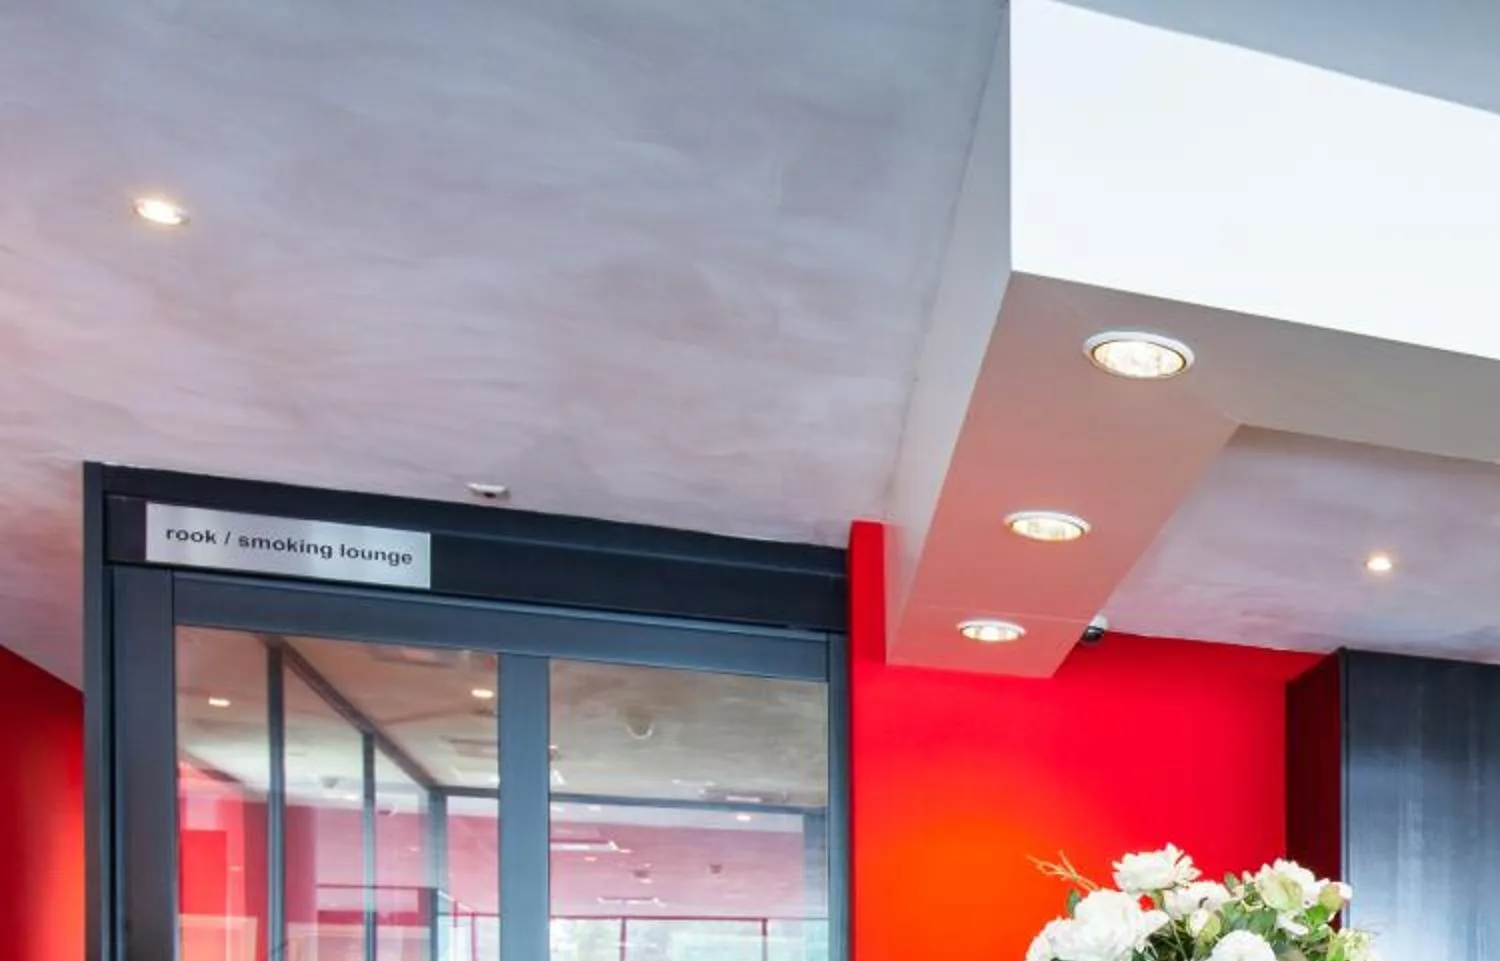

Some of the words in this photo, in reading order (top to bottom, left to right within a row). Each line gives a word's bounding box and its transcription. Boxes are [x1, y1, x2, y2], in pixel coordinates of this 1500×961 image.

[165, 526, 217, 545] rook
[223, 531, 231, 546] /
[237, 535, 333, 560] smoking
[340, 543, 413, 567] lounge
